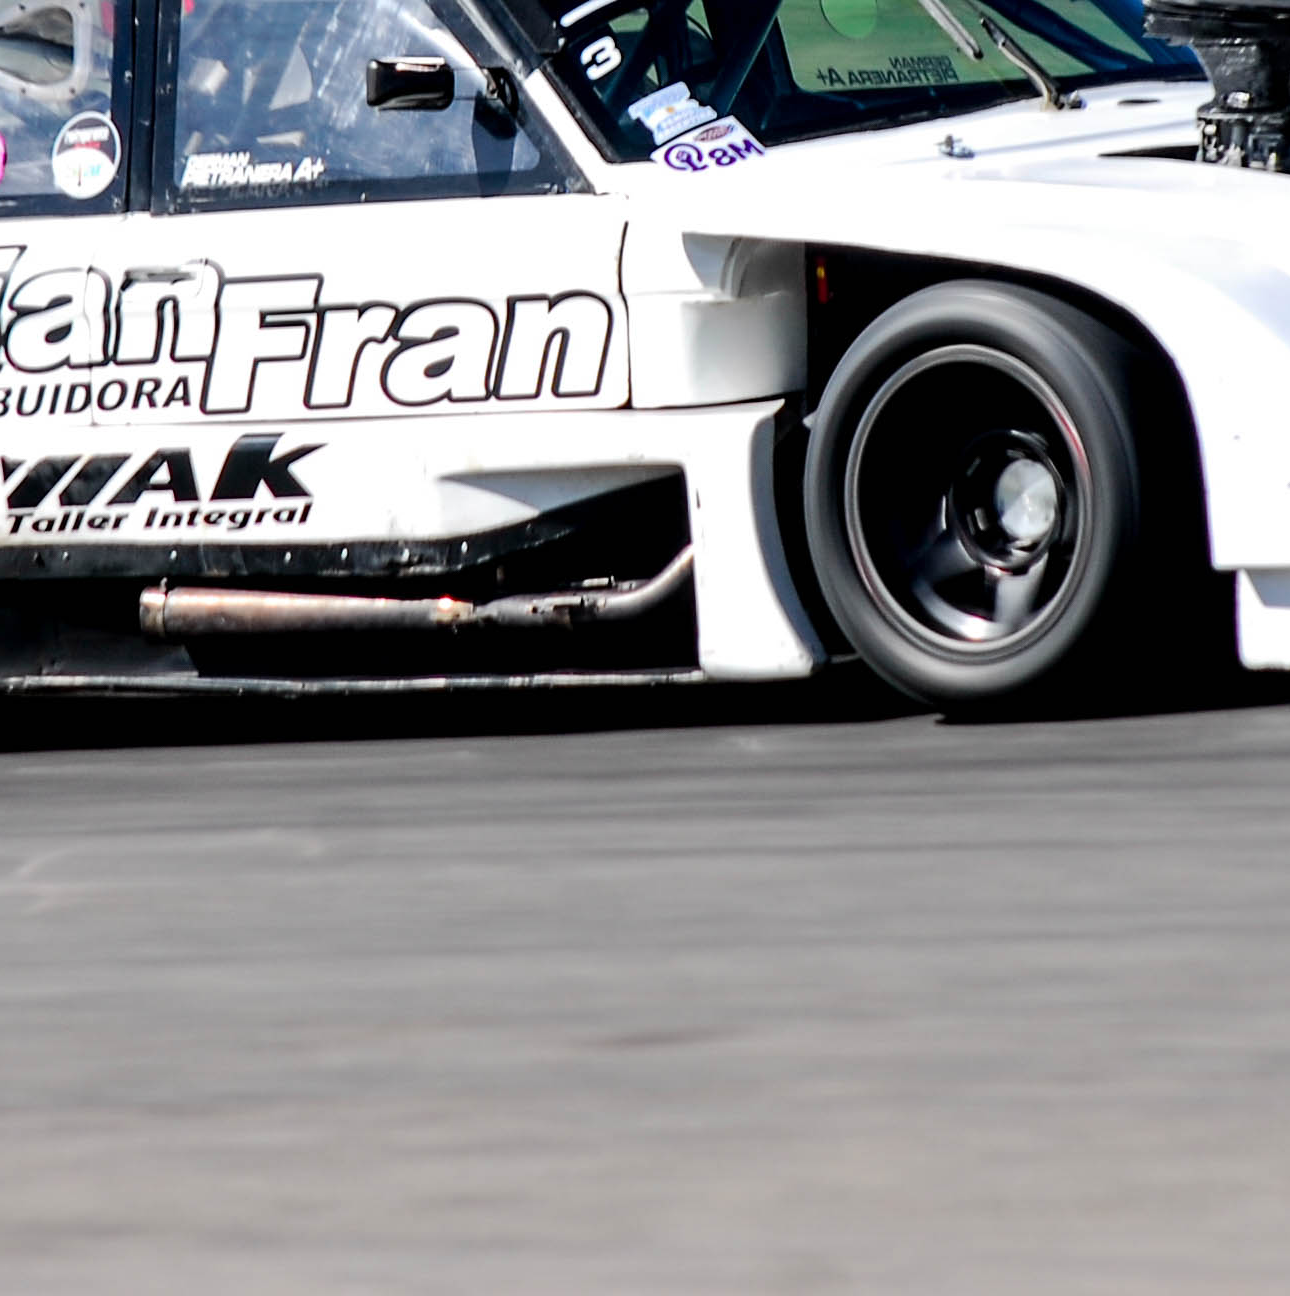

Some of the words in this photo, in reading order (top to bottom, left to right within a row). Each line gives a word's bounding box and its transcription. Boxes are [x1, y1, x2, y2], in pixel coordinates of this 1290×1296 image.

[580, 36, 621, 80] 3
[9, 509, 128, 535] Taller
[144, 503, 313, 531] Integral
